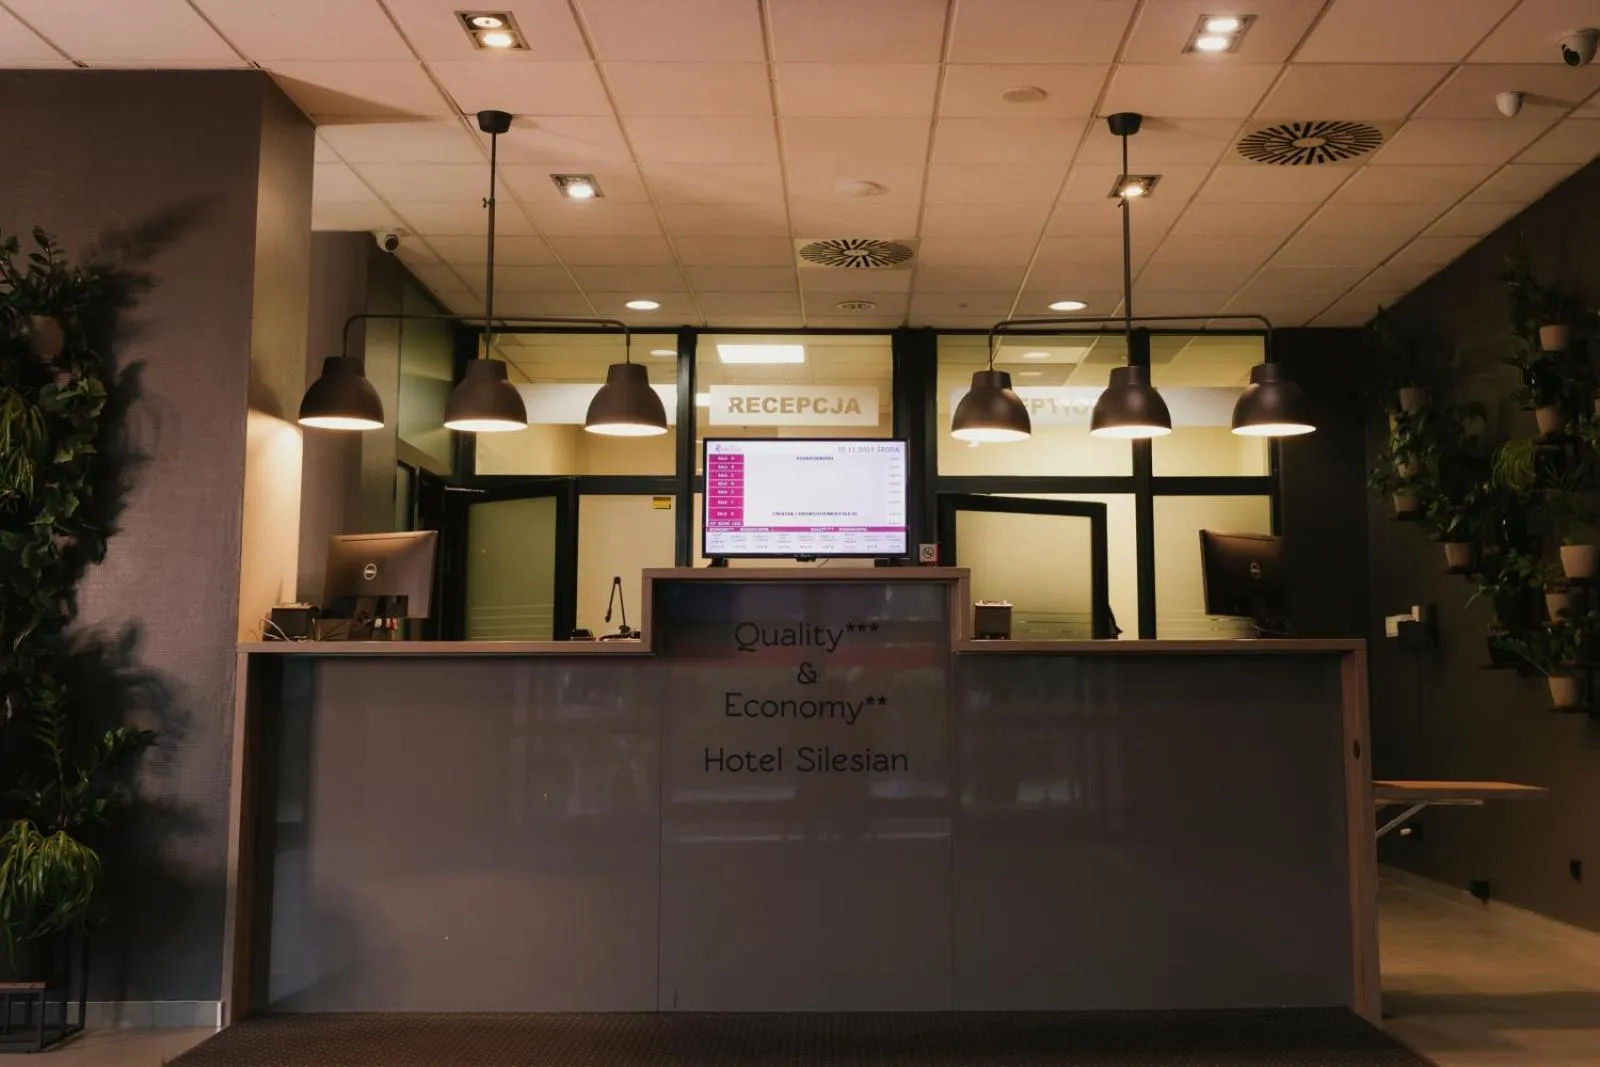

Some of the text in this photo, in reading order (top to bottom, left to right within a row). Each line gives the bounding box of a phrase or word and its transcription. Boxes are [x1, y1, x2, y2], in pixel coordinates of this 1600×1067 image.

[728, 396, 861, 414] RECEPCJA
[797, 661, 818, 684] &
[704, 747, 909, 772] Hotel Silesian
